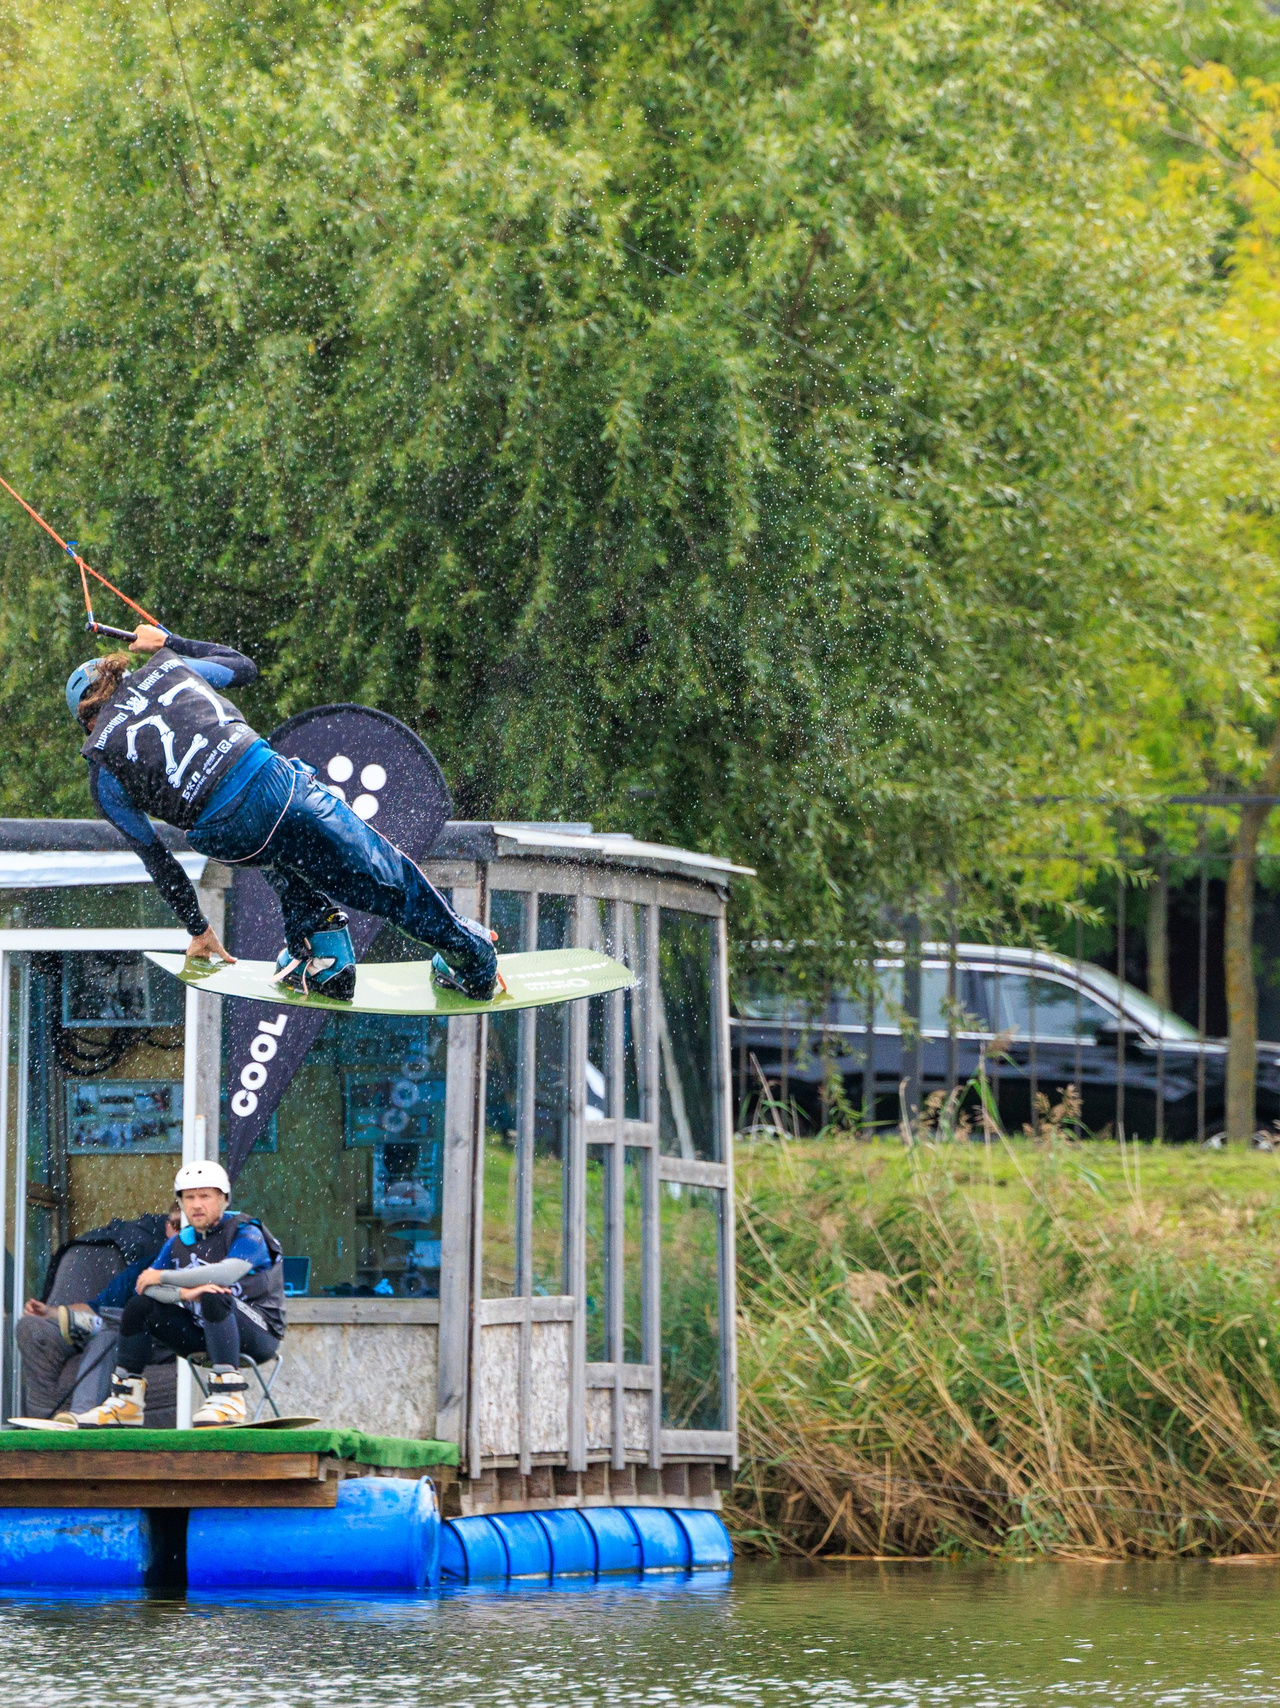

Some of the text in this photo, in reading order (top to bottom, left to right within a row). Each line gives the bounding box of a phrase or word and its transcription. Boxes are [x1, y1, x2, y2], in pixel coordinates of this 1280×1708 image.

[137, 669, 164, 691] WAKE
[159, 659, 185, 673] PA
[231, 1013, 288, 1117] COOL
